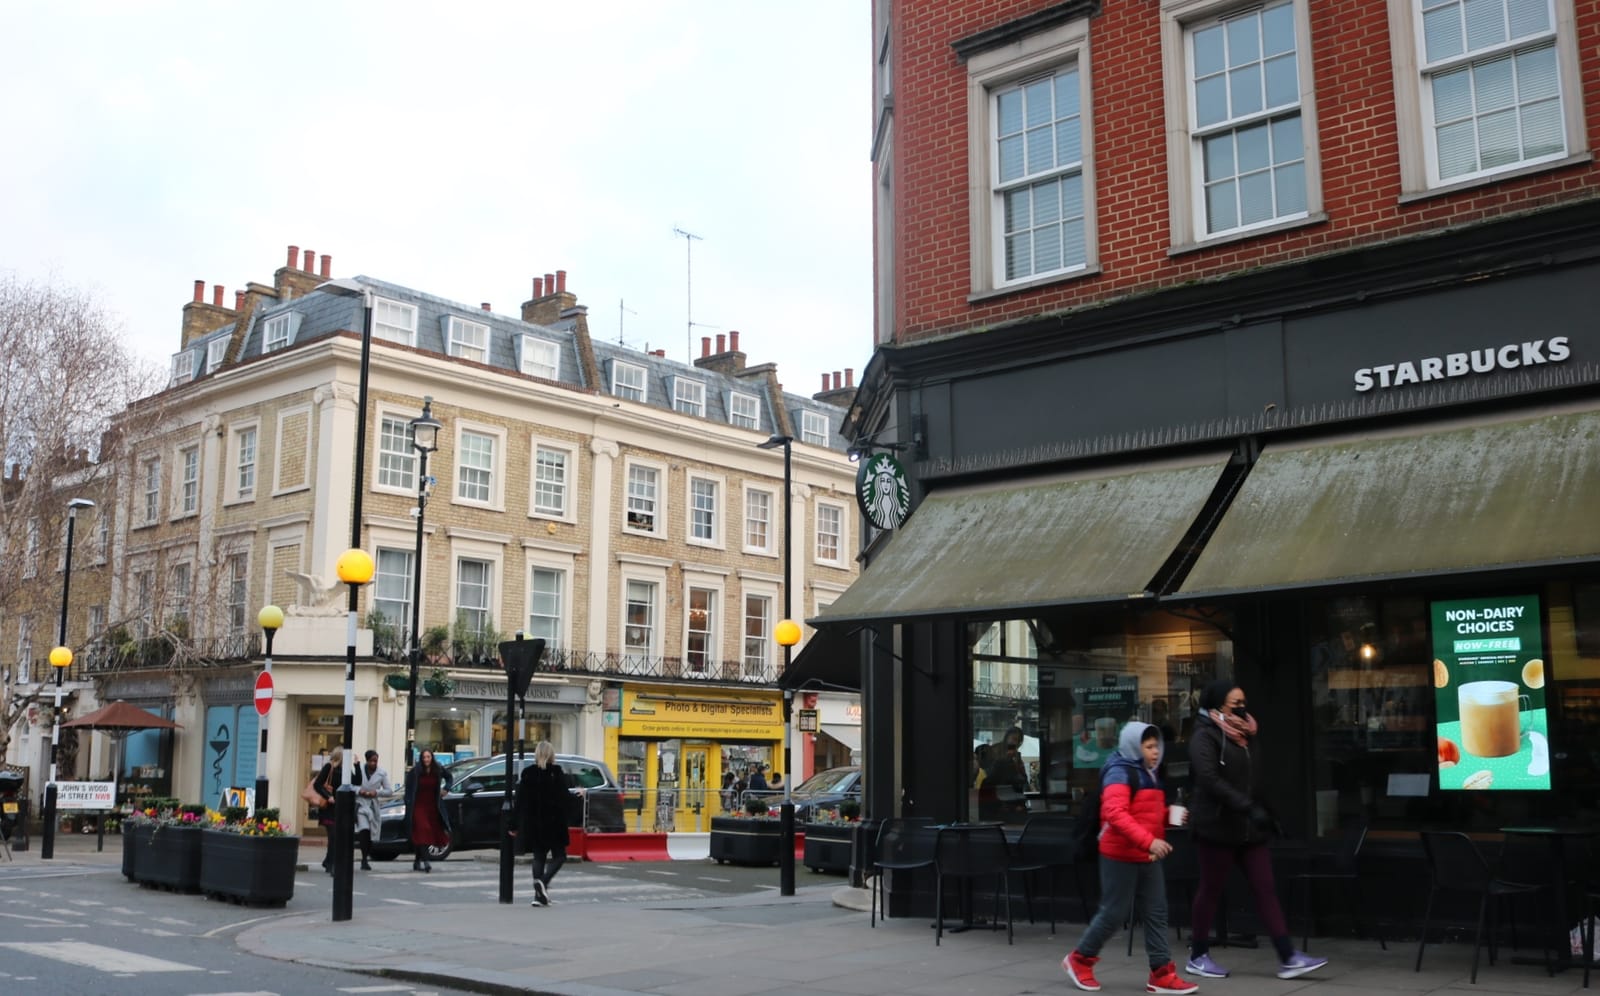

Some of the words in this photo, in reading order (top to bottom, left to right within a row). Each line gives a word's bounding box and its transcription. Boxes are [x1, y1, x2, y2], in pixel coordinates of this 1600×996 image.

[1354, 336, 1570, 392] STARBUCKS
[1446, 606, 1525, 622] NON-DAIRY
[1457, 620, 1514, 634] CHOICES
[664, 701, 690, 713] Photo
[693, 703, 698, 713] &
[701, 703, 727, 716] Digital
[730, 704, 773, 717] Specialists
[56, 792, 66, 800] GH
[68, 792, 93, 800] STREET
[88, 785, 109, 793] WOOD
